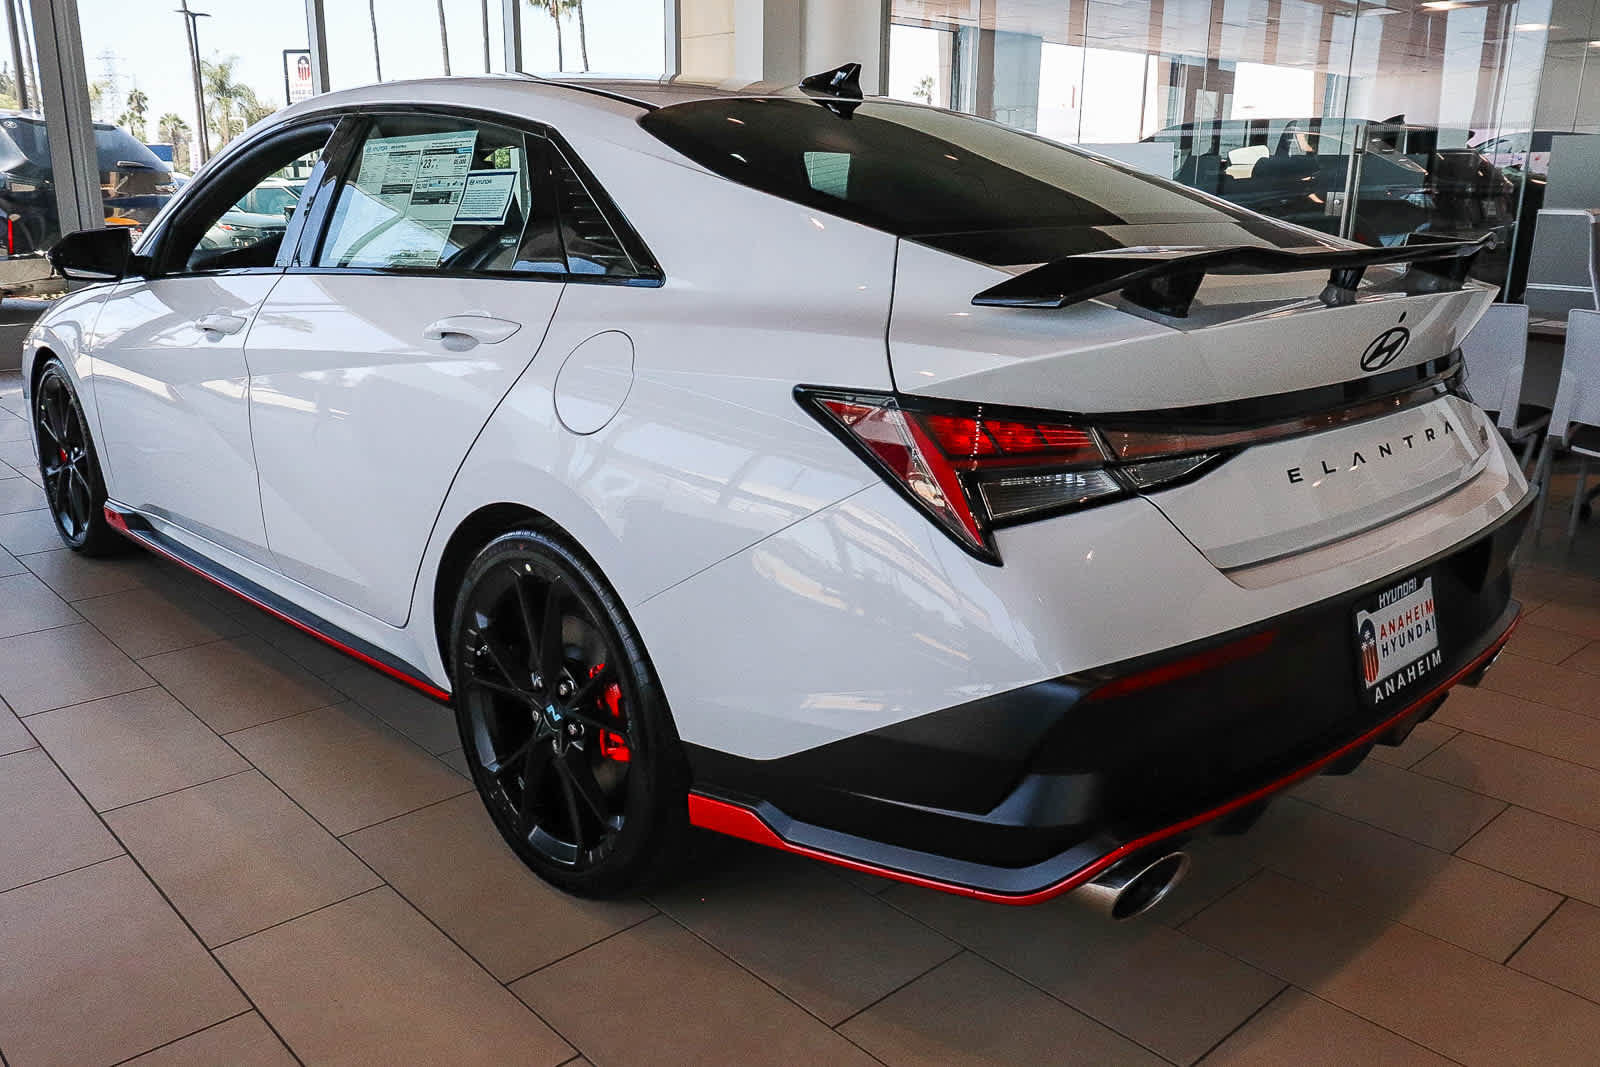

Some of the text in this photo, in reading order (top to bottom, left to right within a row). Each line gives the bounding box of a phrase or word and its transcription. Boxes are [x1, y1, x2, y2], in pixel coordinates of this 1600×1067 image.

[1287, 420, 1454, 484] ELANTRA
[1378, 576, 1417, 609] HYUNDAI
[1380, 598, 1434, 641] ANAHEIM
[1381, 615, 1436, 659] HYUNDAI
[1375, 649, 1441, 704] ANAHEIM
